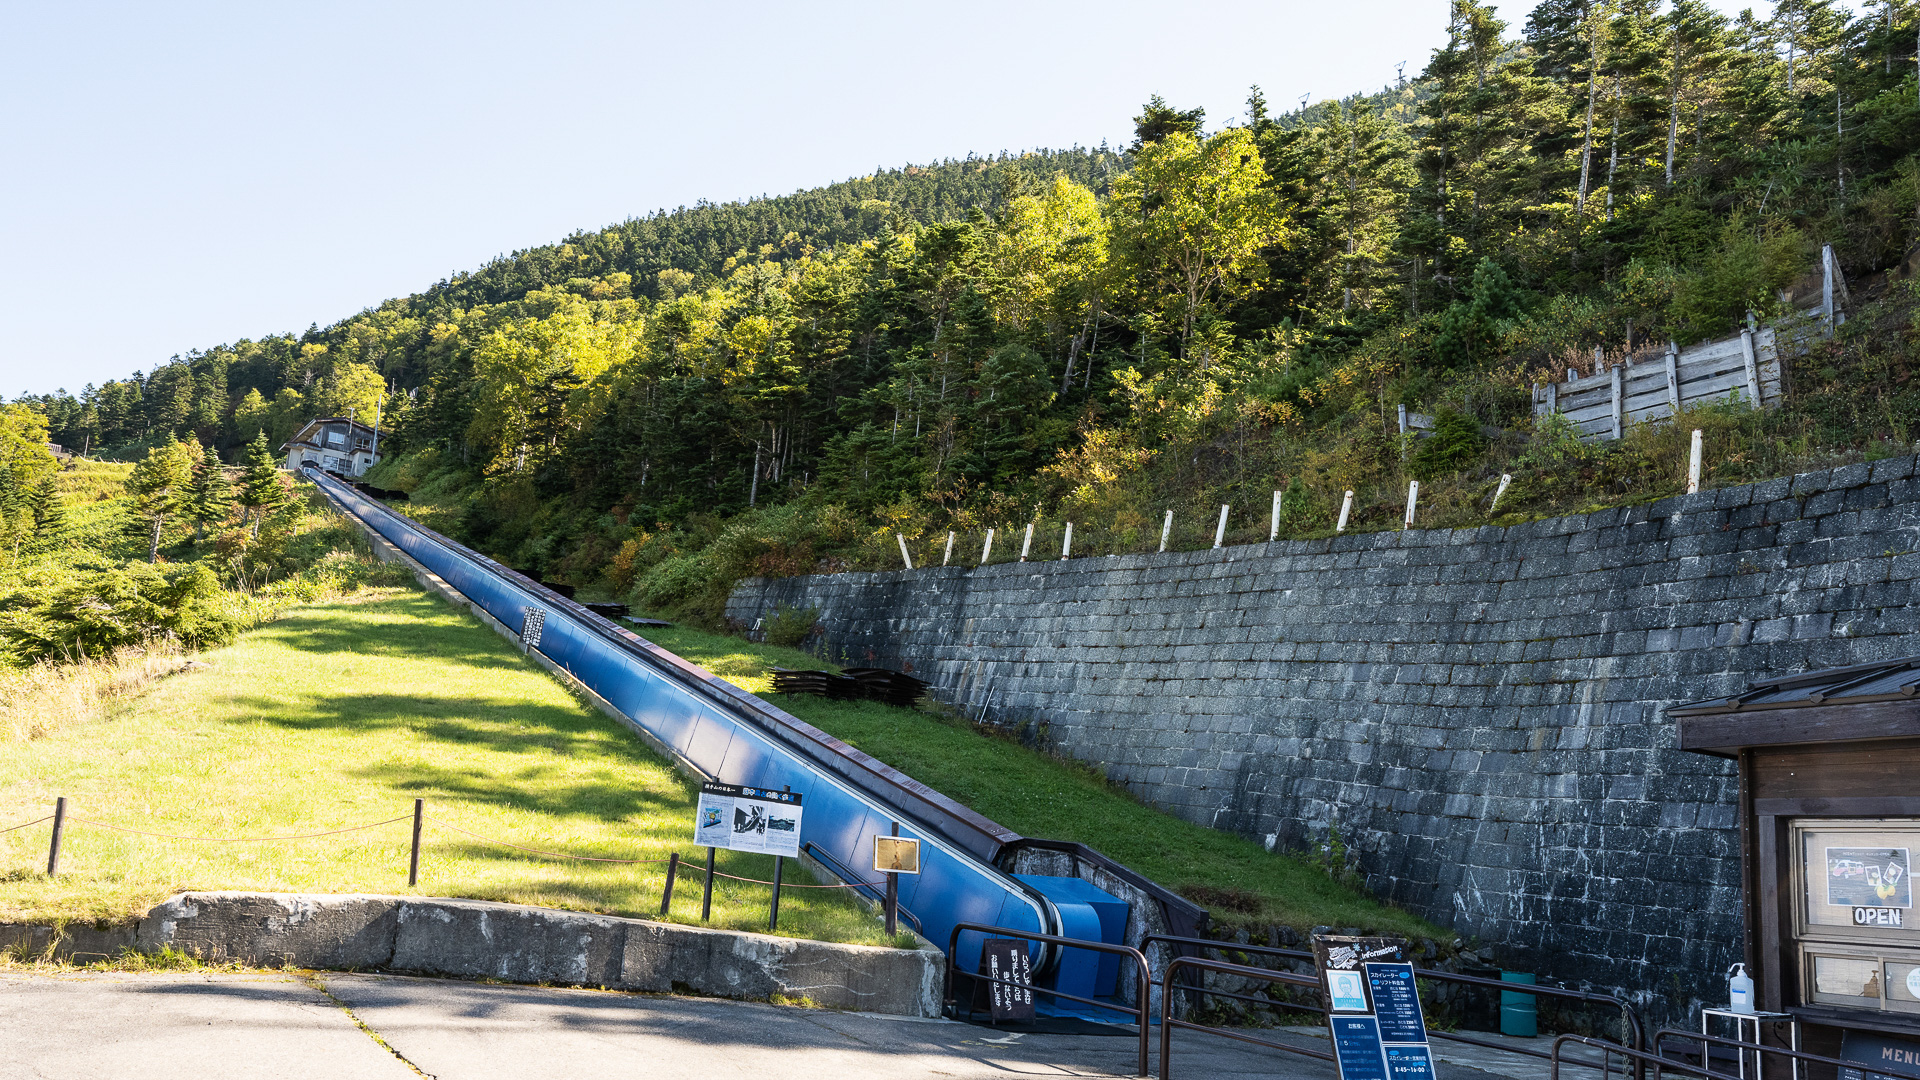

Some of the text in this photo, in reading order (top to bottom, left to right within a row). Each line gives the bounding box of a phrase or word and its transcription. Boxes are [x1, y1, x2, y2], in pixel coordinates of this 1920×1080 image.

[1855, 907, 1901, 925] OPEN
[1022, 954, 1031, 1005] いらっしゃませ
[1881, 1046, 1920, 1066] MENU
